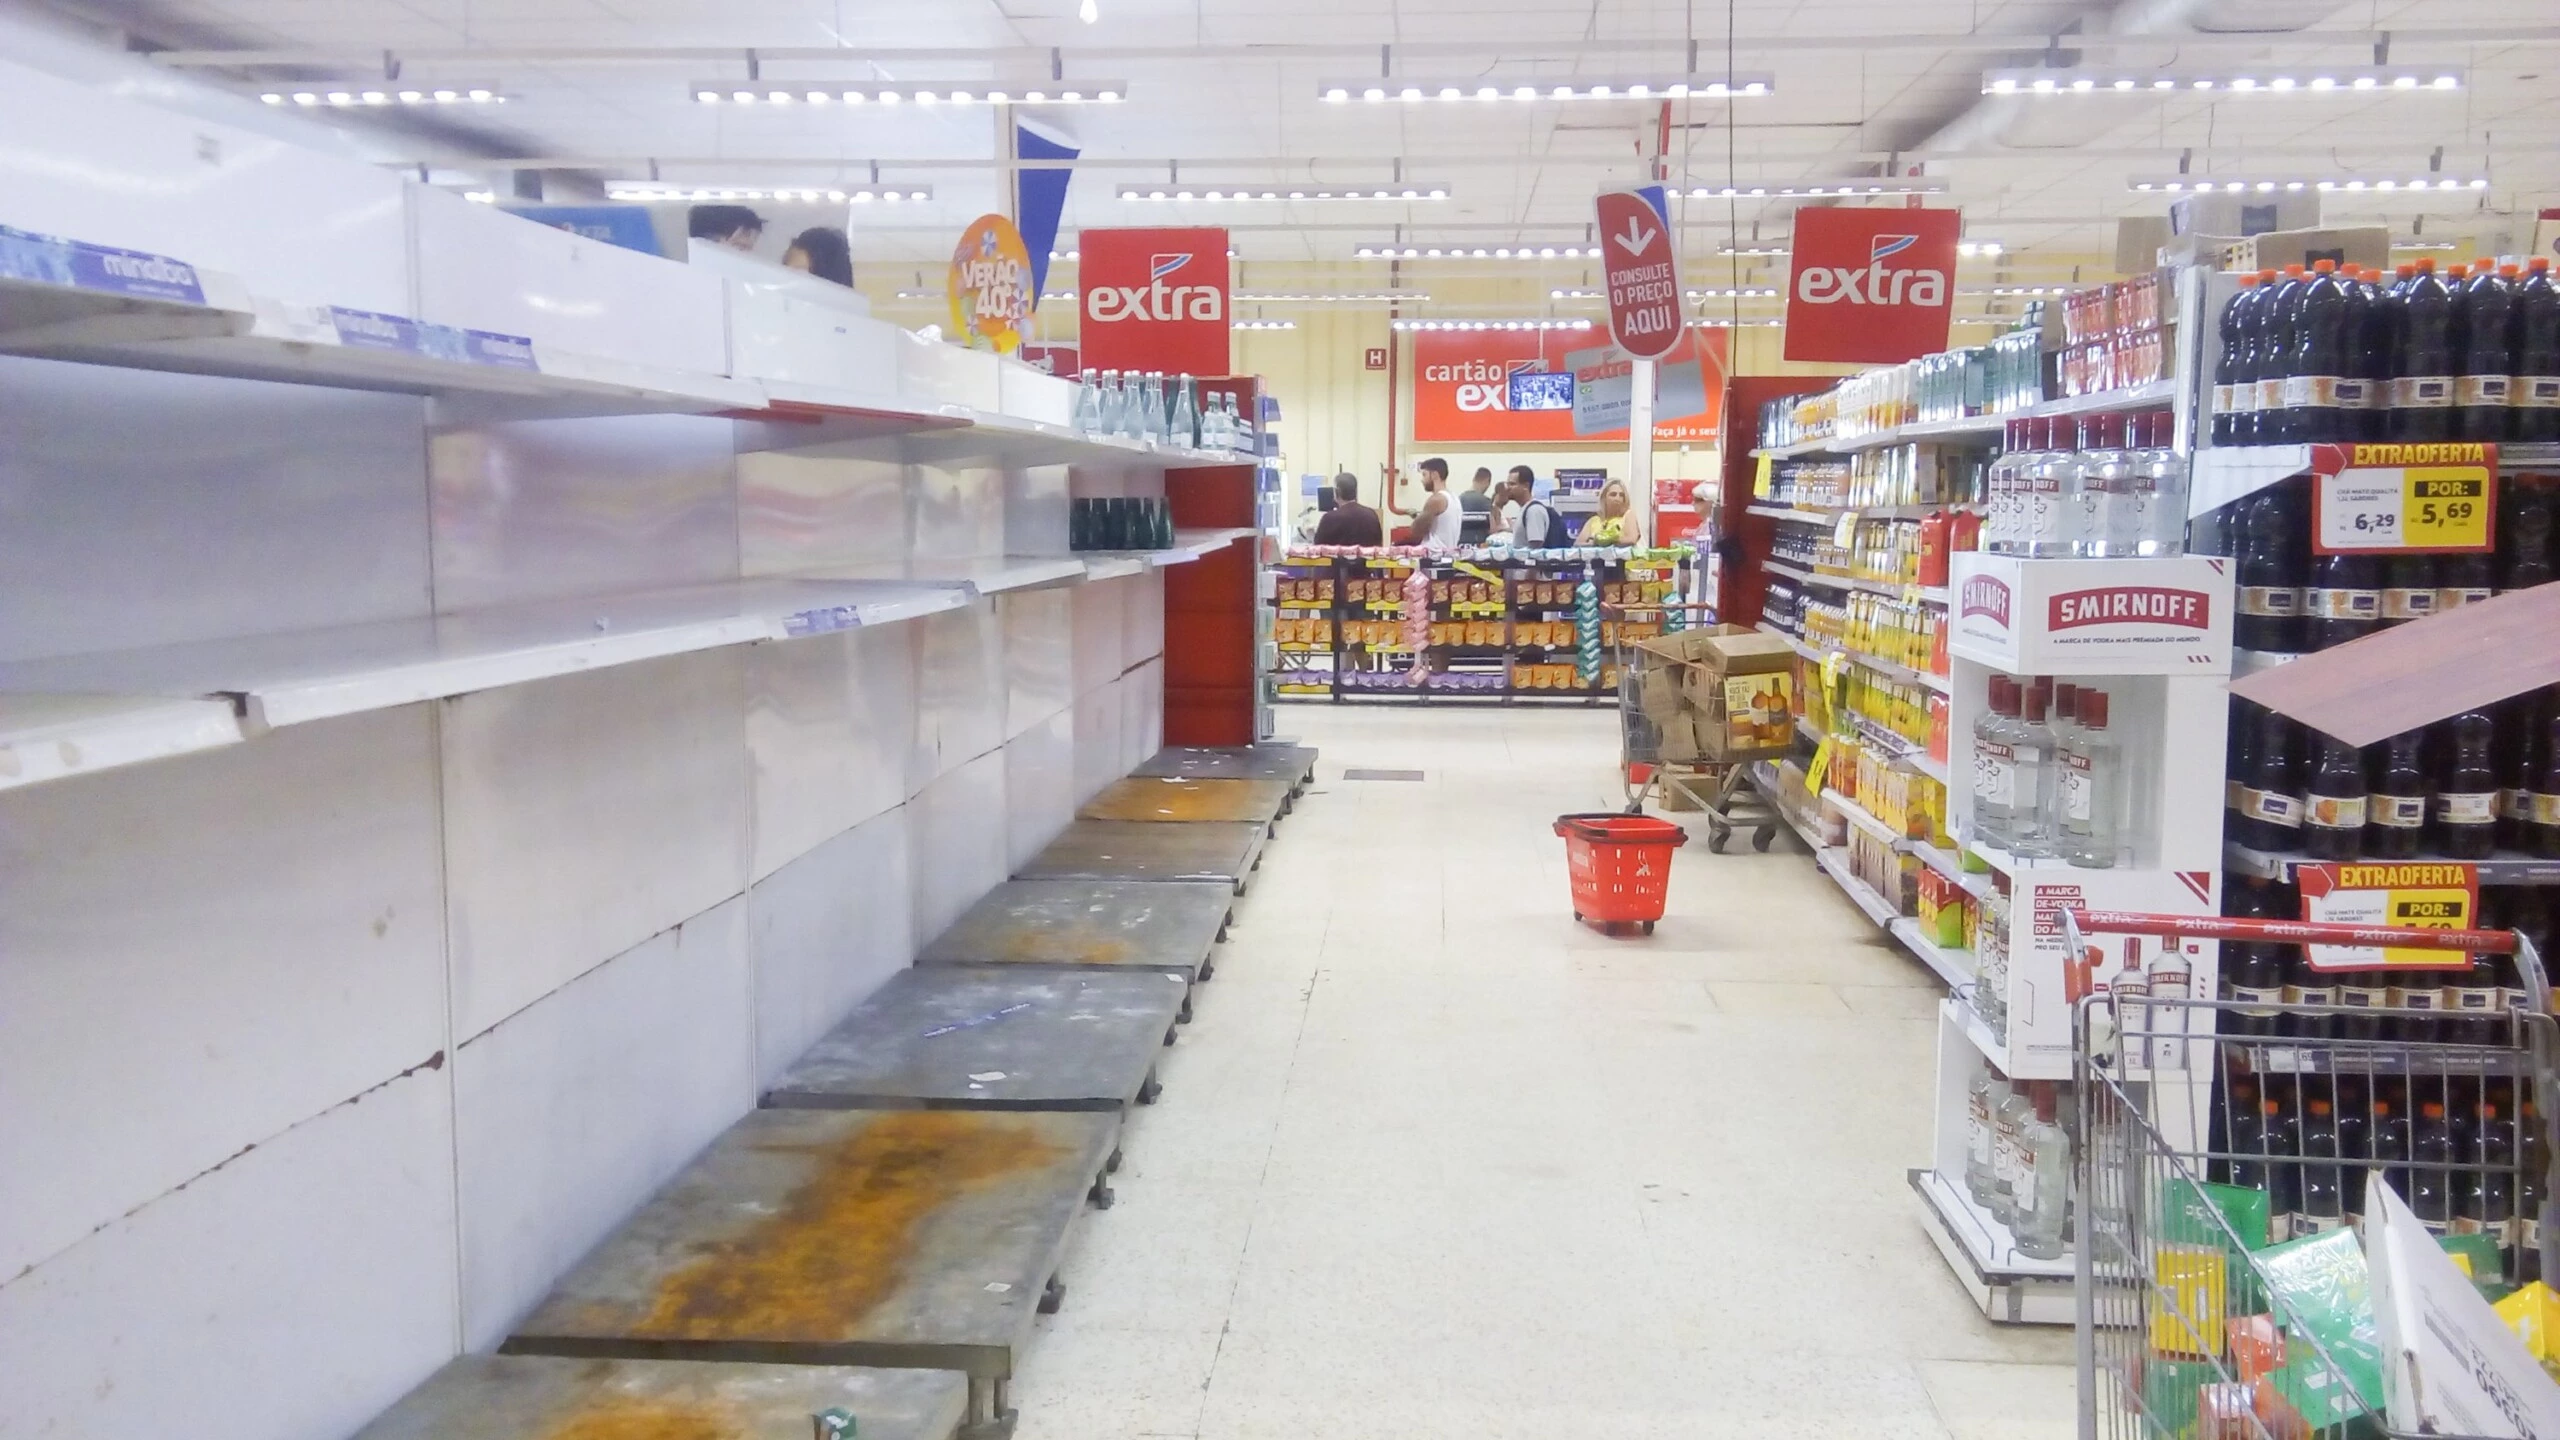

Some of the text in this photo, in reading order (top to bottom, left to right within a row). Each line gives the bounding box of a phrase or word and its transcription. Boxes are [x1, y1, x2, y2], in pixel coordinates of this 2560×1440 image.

[961, 253, 1018, 289] VERÃO
[1610, 262, 1670, 287] CONSULTE
[1614, 280, 1673, 306] O PREÇO
[1798, 259, 1945, 307] extra
[1087, 277, 1222, 322] extra
[1624, 305, 1672, 337] AQUI
[1370, 351, 1382, 365] H
[1425, 359, 1501, 382] cartão
[2354, 444, 2485, 465] EXTRAOFERTA
[2427, 482, 2469, 496] POR:
[2354, 513, 2395, 534] 6,29
[2421, 502, 2472, 528] 5,69
[1964, 581, 2007, 617] SMIRNOFF
[2060, 593, 2197, 623] SMIRNOFF
[2340, 866, 2465, 887] EXTRAOFERTA
[2036, 886, 2079, 895] A MARCA
[2090, 911, 2132, 924] extra
[2410, 903, 2450, 916] POR:
[2035, 925, 2050, 934] DO
[2176, 917, 2220, 930] extra
[2263, 922, 2308, 936] extra
[2353, 929, 2399, 942] extra
[2438, 933, 2482, 947] extra
